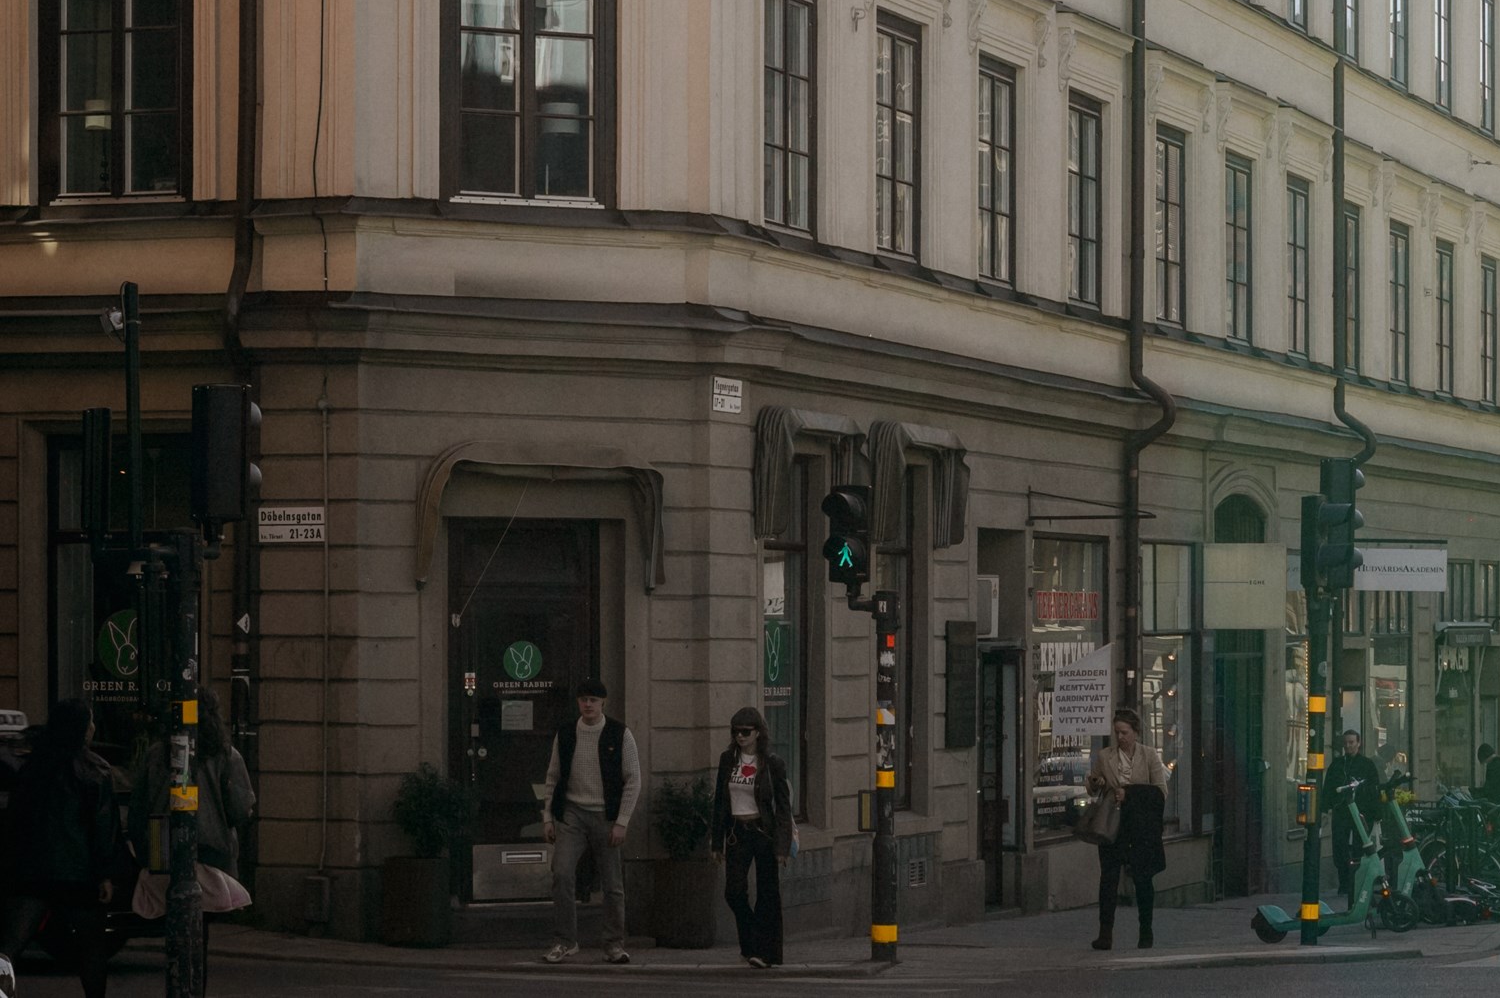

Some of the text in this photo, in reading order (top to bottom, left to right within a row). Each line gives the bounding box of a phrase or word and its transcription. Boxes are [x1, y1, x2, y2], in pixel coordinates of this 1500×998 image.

[261, 510, 322, 524] Döbelnsgatan
[290, 528, 322, 539] 21-23A
[1058, 669, 1108, 678] SKRÄDDERI
[83, 681, 123, 691] GREEN
[493, 681, 521, 689] GREEN
[1059, 683, 1106, 692] KEMTVÄTT
[1055, 694, 1110, 703] GARDINTVÄTT
[1058, 705, 1106, 713] MATTVÄTT
[1058, 716, 1105, 724] VITTVÄTT
